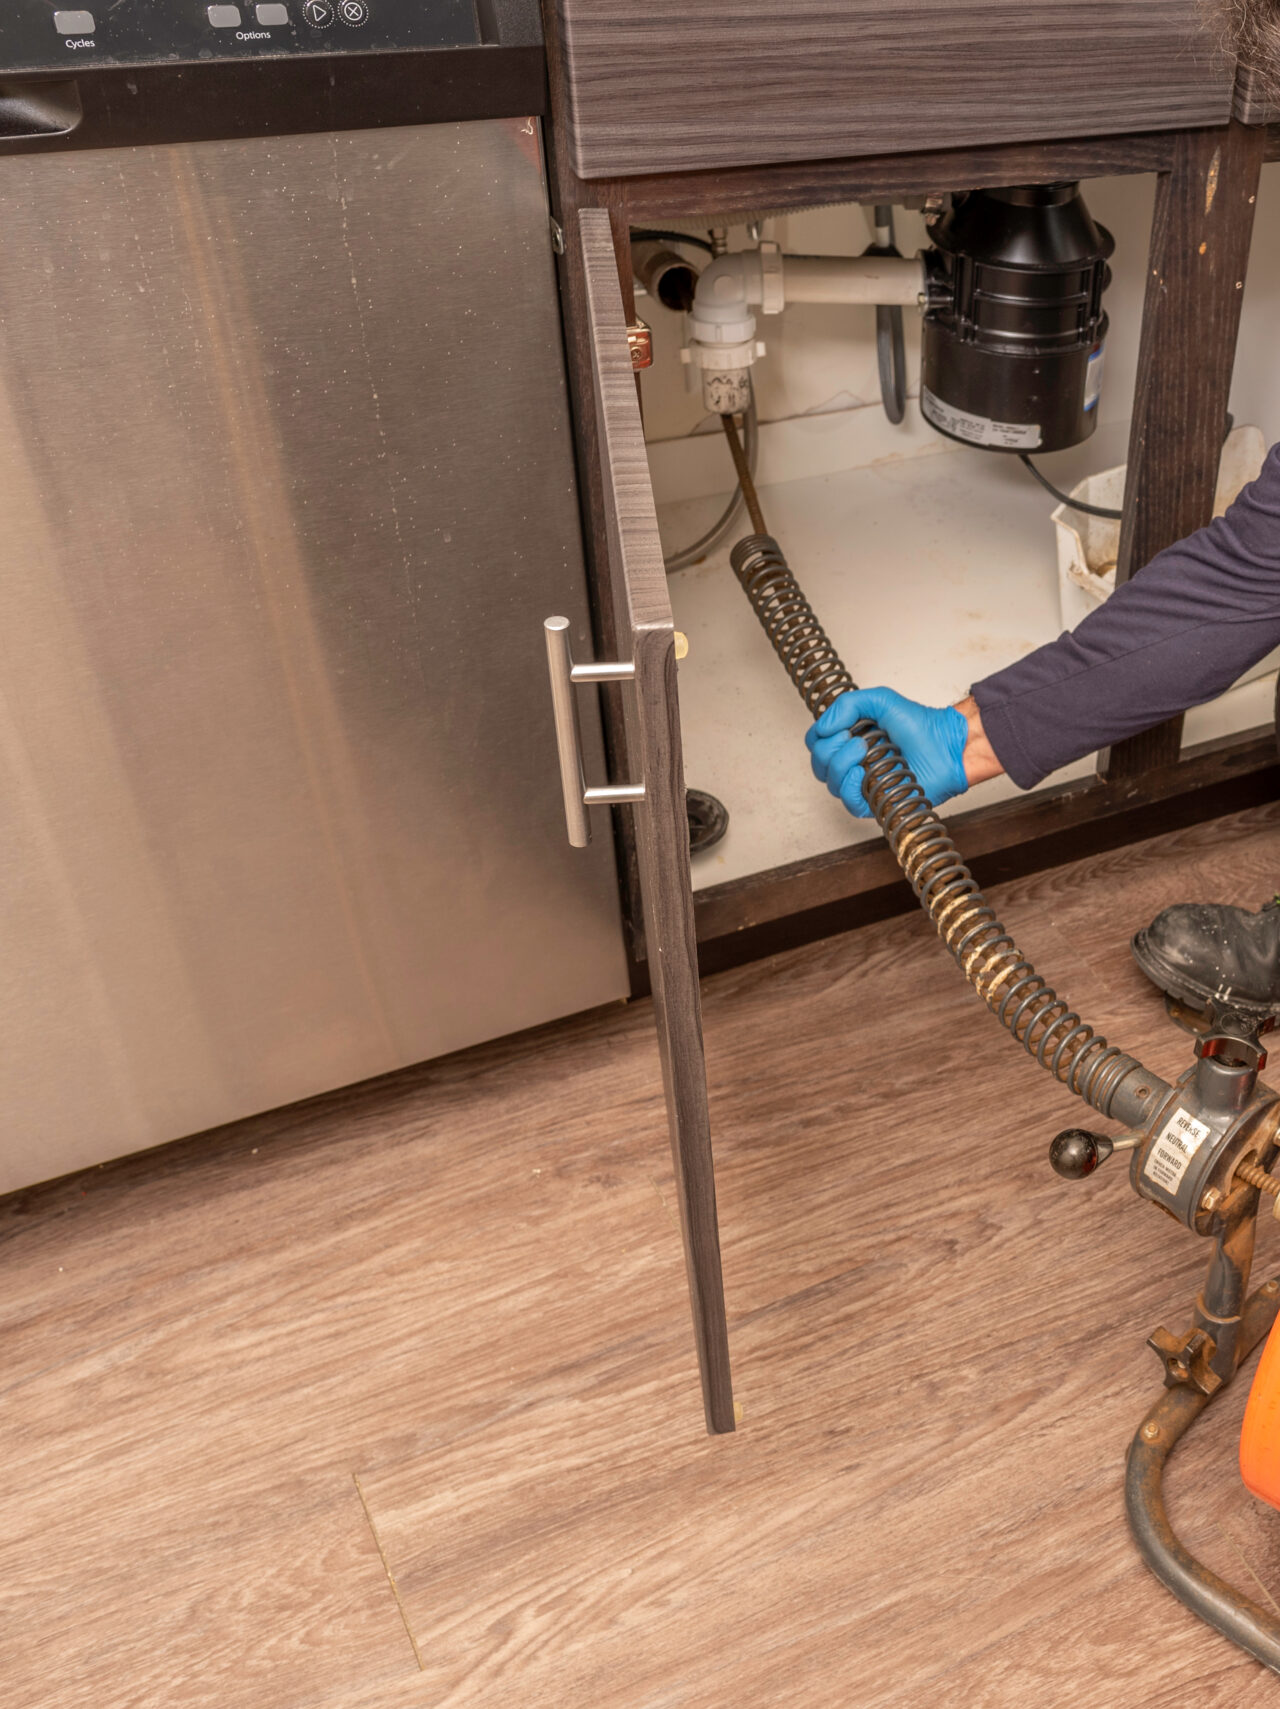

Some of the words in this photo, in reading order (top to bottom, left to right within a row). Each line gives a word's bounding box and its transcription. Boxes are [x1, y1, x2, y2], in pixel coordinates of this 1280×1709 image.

[65, 39, 96, 49] Cycles
[236, 31, 271, 41] Options
[1176, 1116, 1201, 1138] REVERSE
[1166, 1132, 1188, 1153] NEUTRAL
[1157, 1148, 1182, 1170] FORWARD
